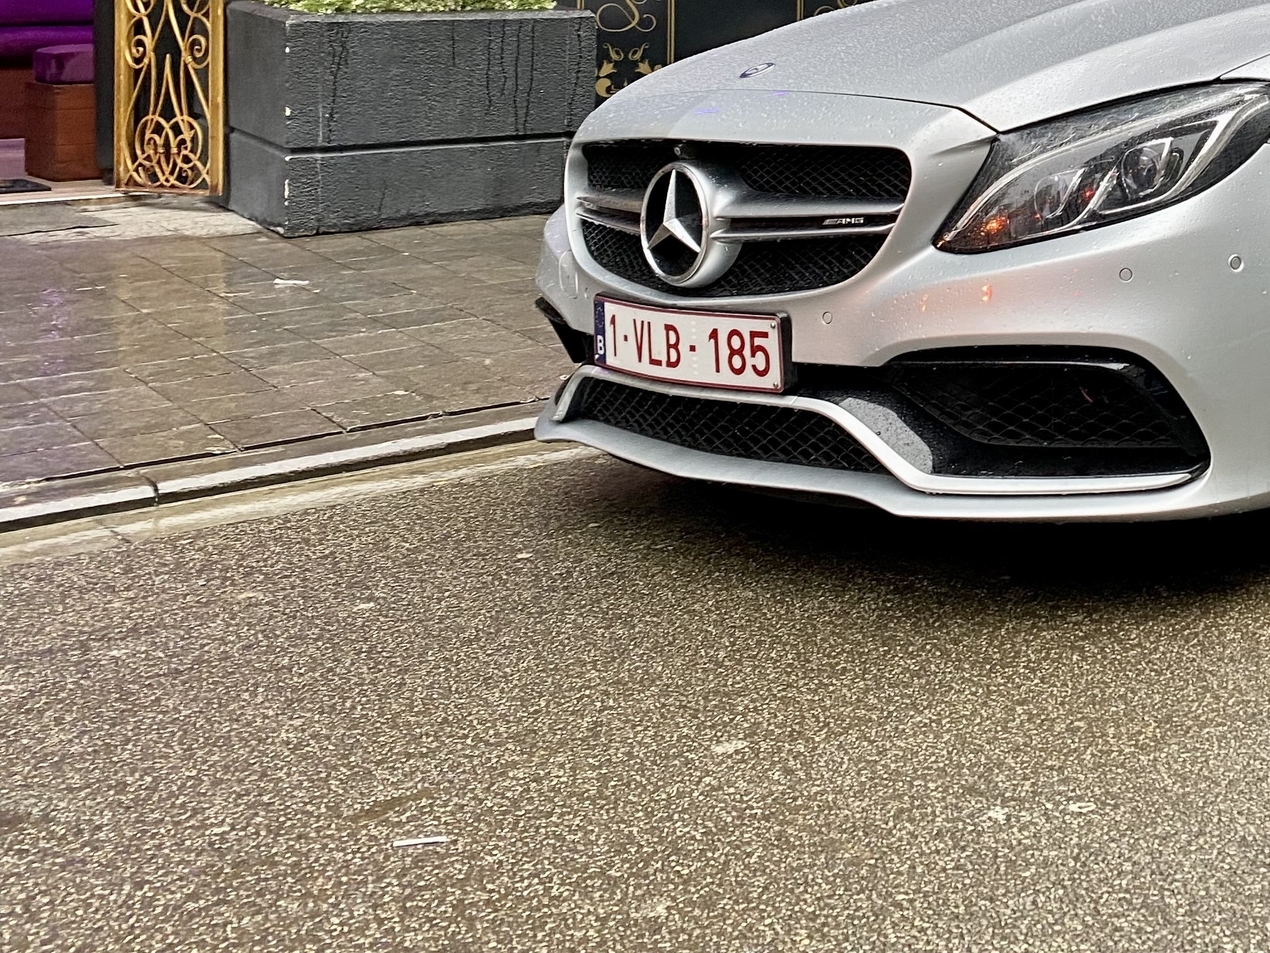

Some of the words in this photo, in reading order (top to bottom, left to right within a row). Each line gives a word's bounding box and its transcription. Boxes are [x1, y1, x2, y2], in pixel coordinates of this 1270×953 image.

[835, 216, 865, 225] AMG
[596, 334, 605, 355] B
[609, 313, 771, 378] 1-VLB-185
